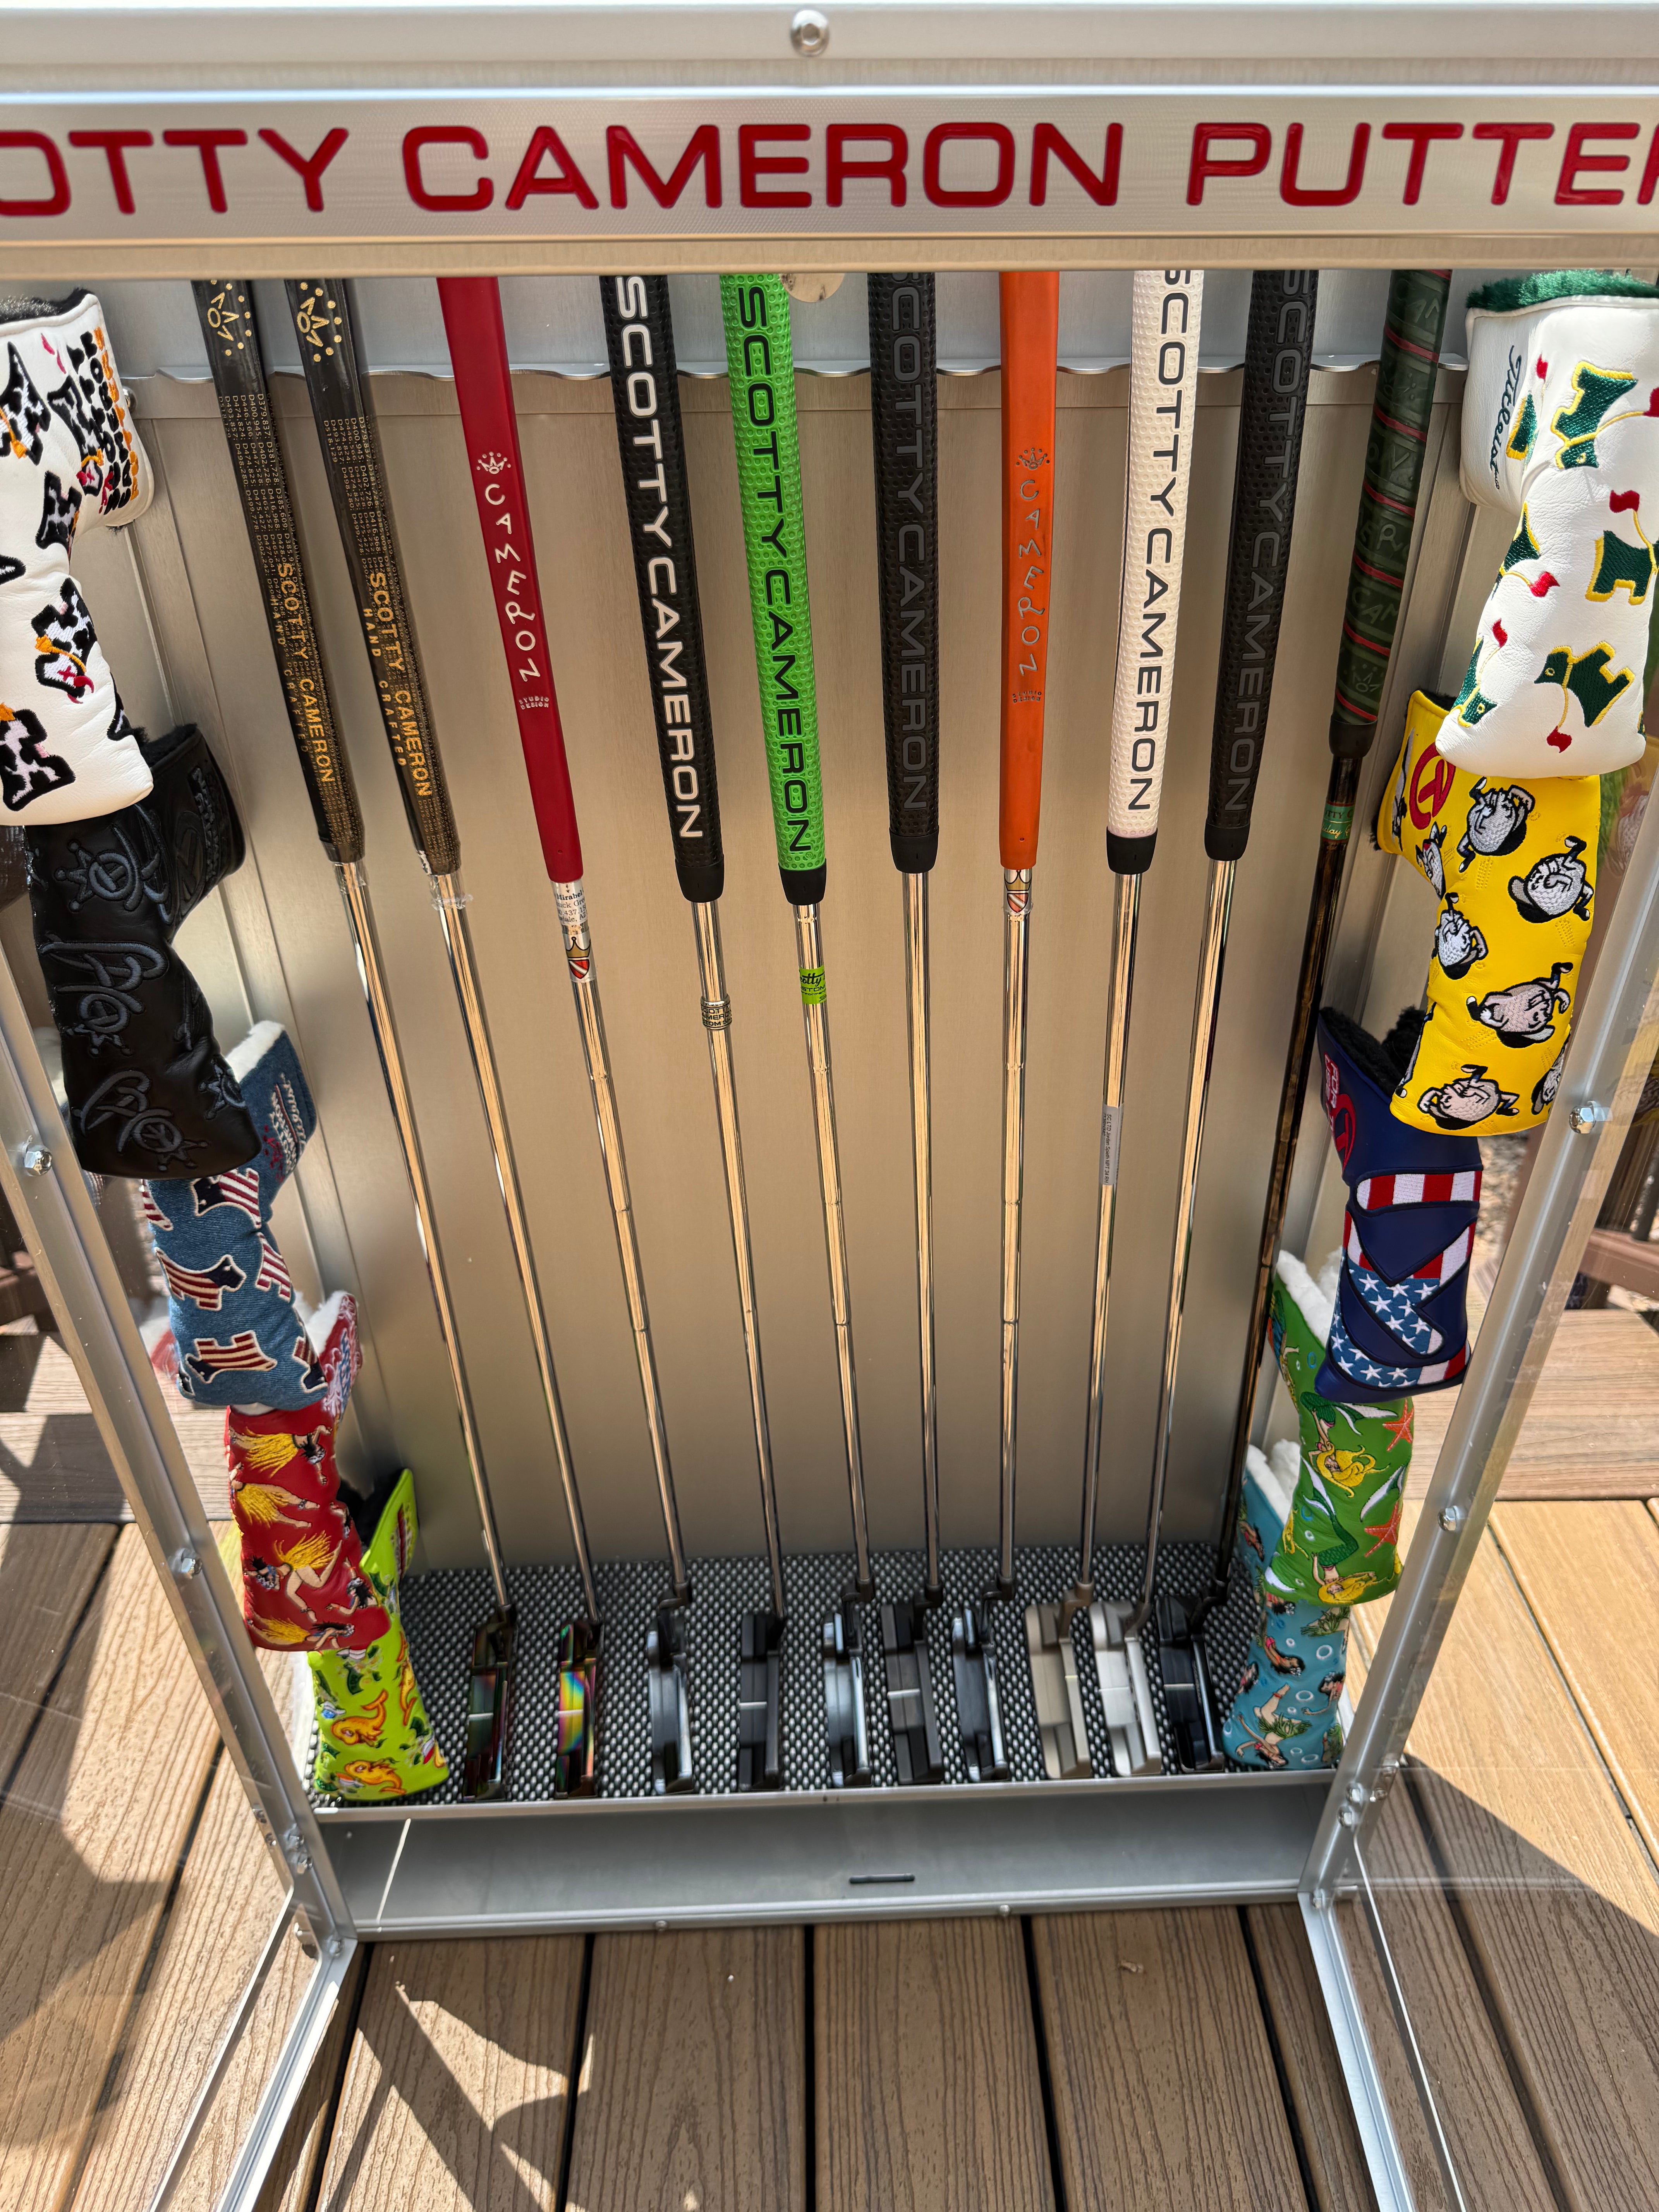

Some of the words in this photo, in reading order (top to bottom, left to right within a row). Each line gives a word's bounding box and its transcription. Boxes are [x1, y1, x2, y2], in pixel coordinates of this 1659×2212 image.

[402, 122, 1123, 213] CAMERON
[1187, 122, 1659, 206] PUTTE
[80, 331, 132, 508] CAMERON
[239, 394, 253, 440] D446,566;
[249, 442, 264, 486] D447,528;
[259, 488, 273, 531] D465,252;
[247, 394, 262, 440] D400,945;
[257, 441, 271, 486] D402,726;
[266, 488, 280, 531] D416,968;
[256, 393, 270, 439] D379,837;
[265, 441, 280, 486] D381,728;
[275, 488, 288, 531] D385,609;
[323, 420, 338, 463] D518,129
[891, 273, 924, 514] COTTY
[224, 395, 238, 440] D493,857;
[234, 443, 249, 487] D498,280;
[245, 489, 259, 532] D499,778;
[256, 534, 270, 576] D502,242;
[232, 395, 246, 440] D474,824;
[242, 443, 256, 487] D474,825;
[252, 489, 266, 532] D475,427;
[262, 534, 276, 575] D477,041;
[330, 419, 345, 465] D493,857;
[341, 467, 355, 511] D498,280;
[351, 513, 365, 556] D499,778;
[337, 419, 351, 464] D474,824;
[347, 466, 361, 510] D474,825;
[357, 512, 370, 555] D475,427;
[350, 417, 364, 462] D400,945;
[359, 465, 373, 509] D402,726;
[368, 511, 382, 554] D416,968;
[358, 416, 371, 462] D379,837;
[367, 464, 380, 508] D381,728;
[383, 556, 395, 597] D385,935;
[616, 276, 672, 547] SCOTTY
[648, 557, 703, 838] CAMERON
[738, 287, 787, 558] SCOTTY
[765, 568, 811, 852] CAMERON
[485, 483, 540, 682] CAMERON
[1018, 479, 1045, 676] CAMERON
[278, 563, 310, 660] SCOTTY
[299, 679, 336, 783] CAMERON
[284, 669, 307, 752] CRAFTED
[363, 608, 381, 657] HAND
[379, 680, 407, 767] CRAFTED
[370, 572, 404, 672] SCOTTY
[395, 690, 432, 797] CAMERON
[519, 696, 550, 705] STUDIO
[520, 702, 549, 710] DESIGN
[898, 525, 928, 810] CAMERON
[1128, 528, 1172, 810] CAMERON
[1224, 532, 1281, 811] CAMERON
